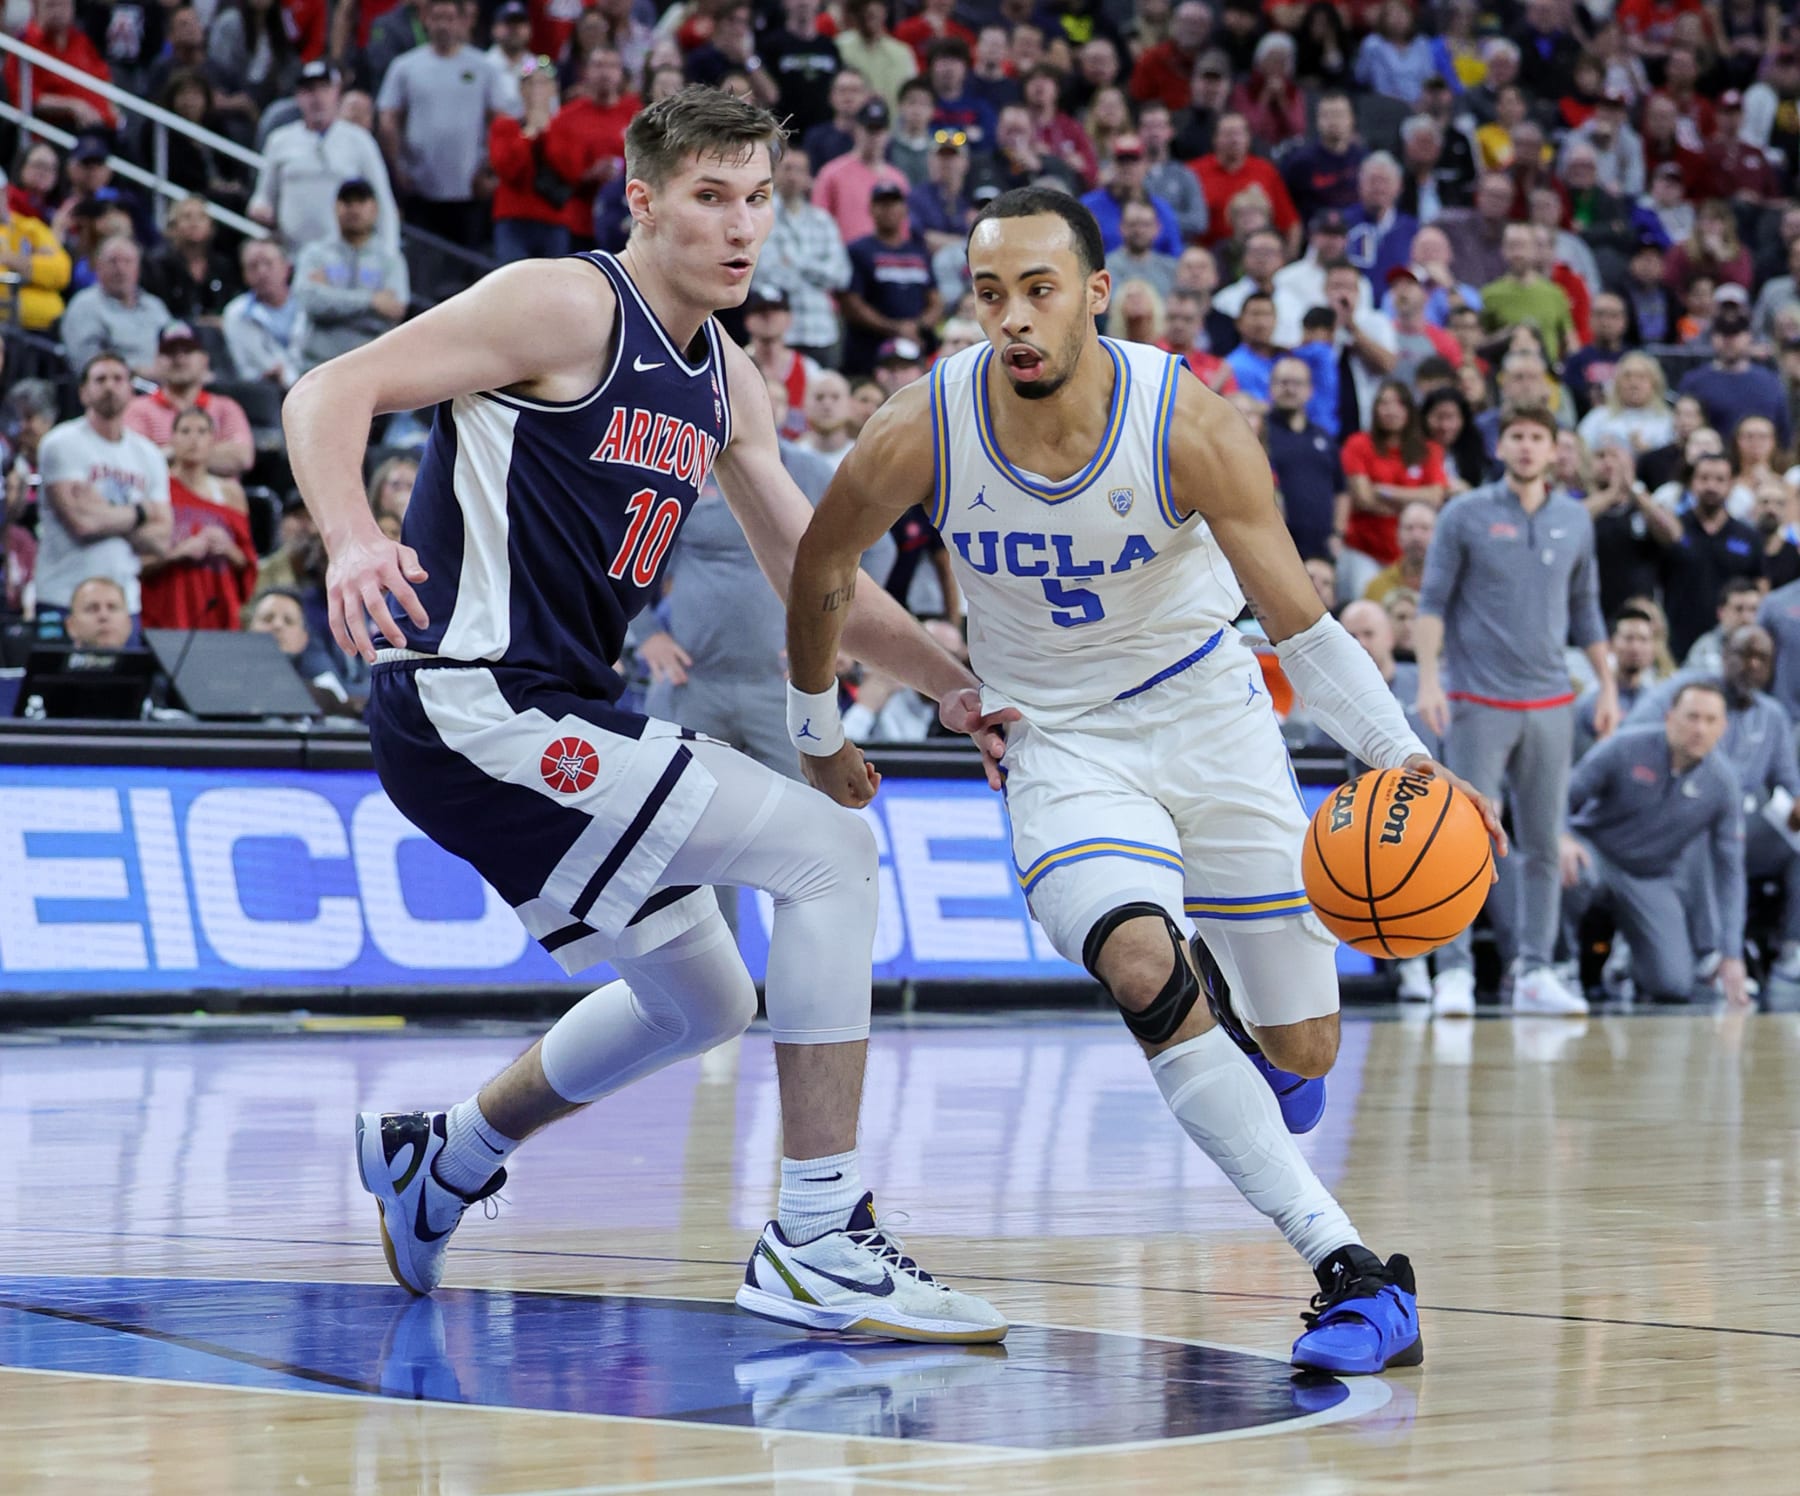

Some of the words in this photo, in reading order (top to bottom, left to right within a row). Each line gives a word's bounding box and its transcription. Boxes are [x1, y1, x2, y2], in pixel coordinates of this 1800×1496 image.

[589, 406, 720, 495] ARIZON
[607, 487, 682, 588] 10
[952, 531, 1159, 577] UCLA
[1040, 577, 1106, 628] 5
